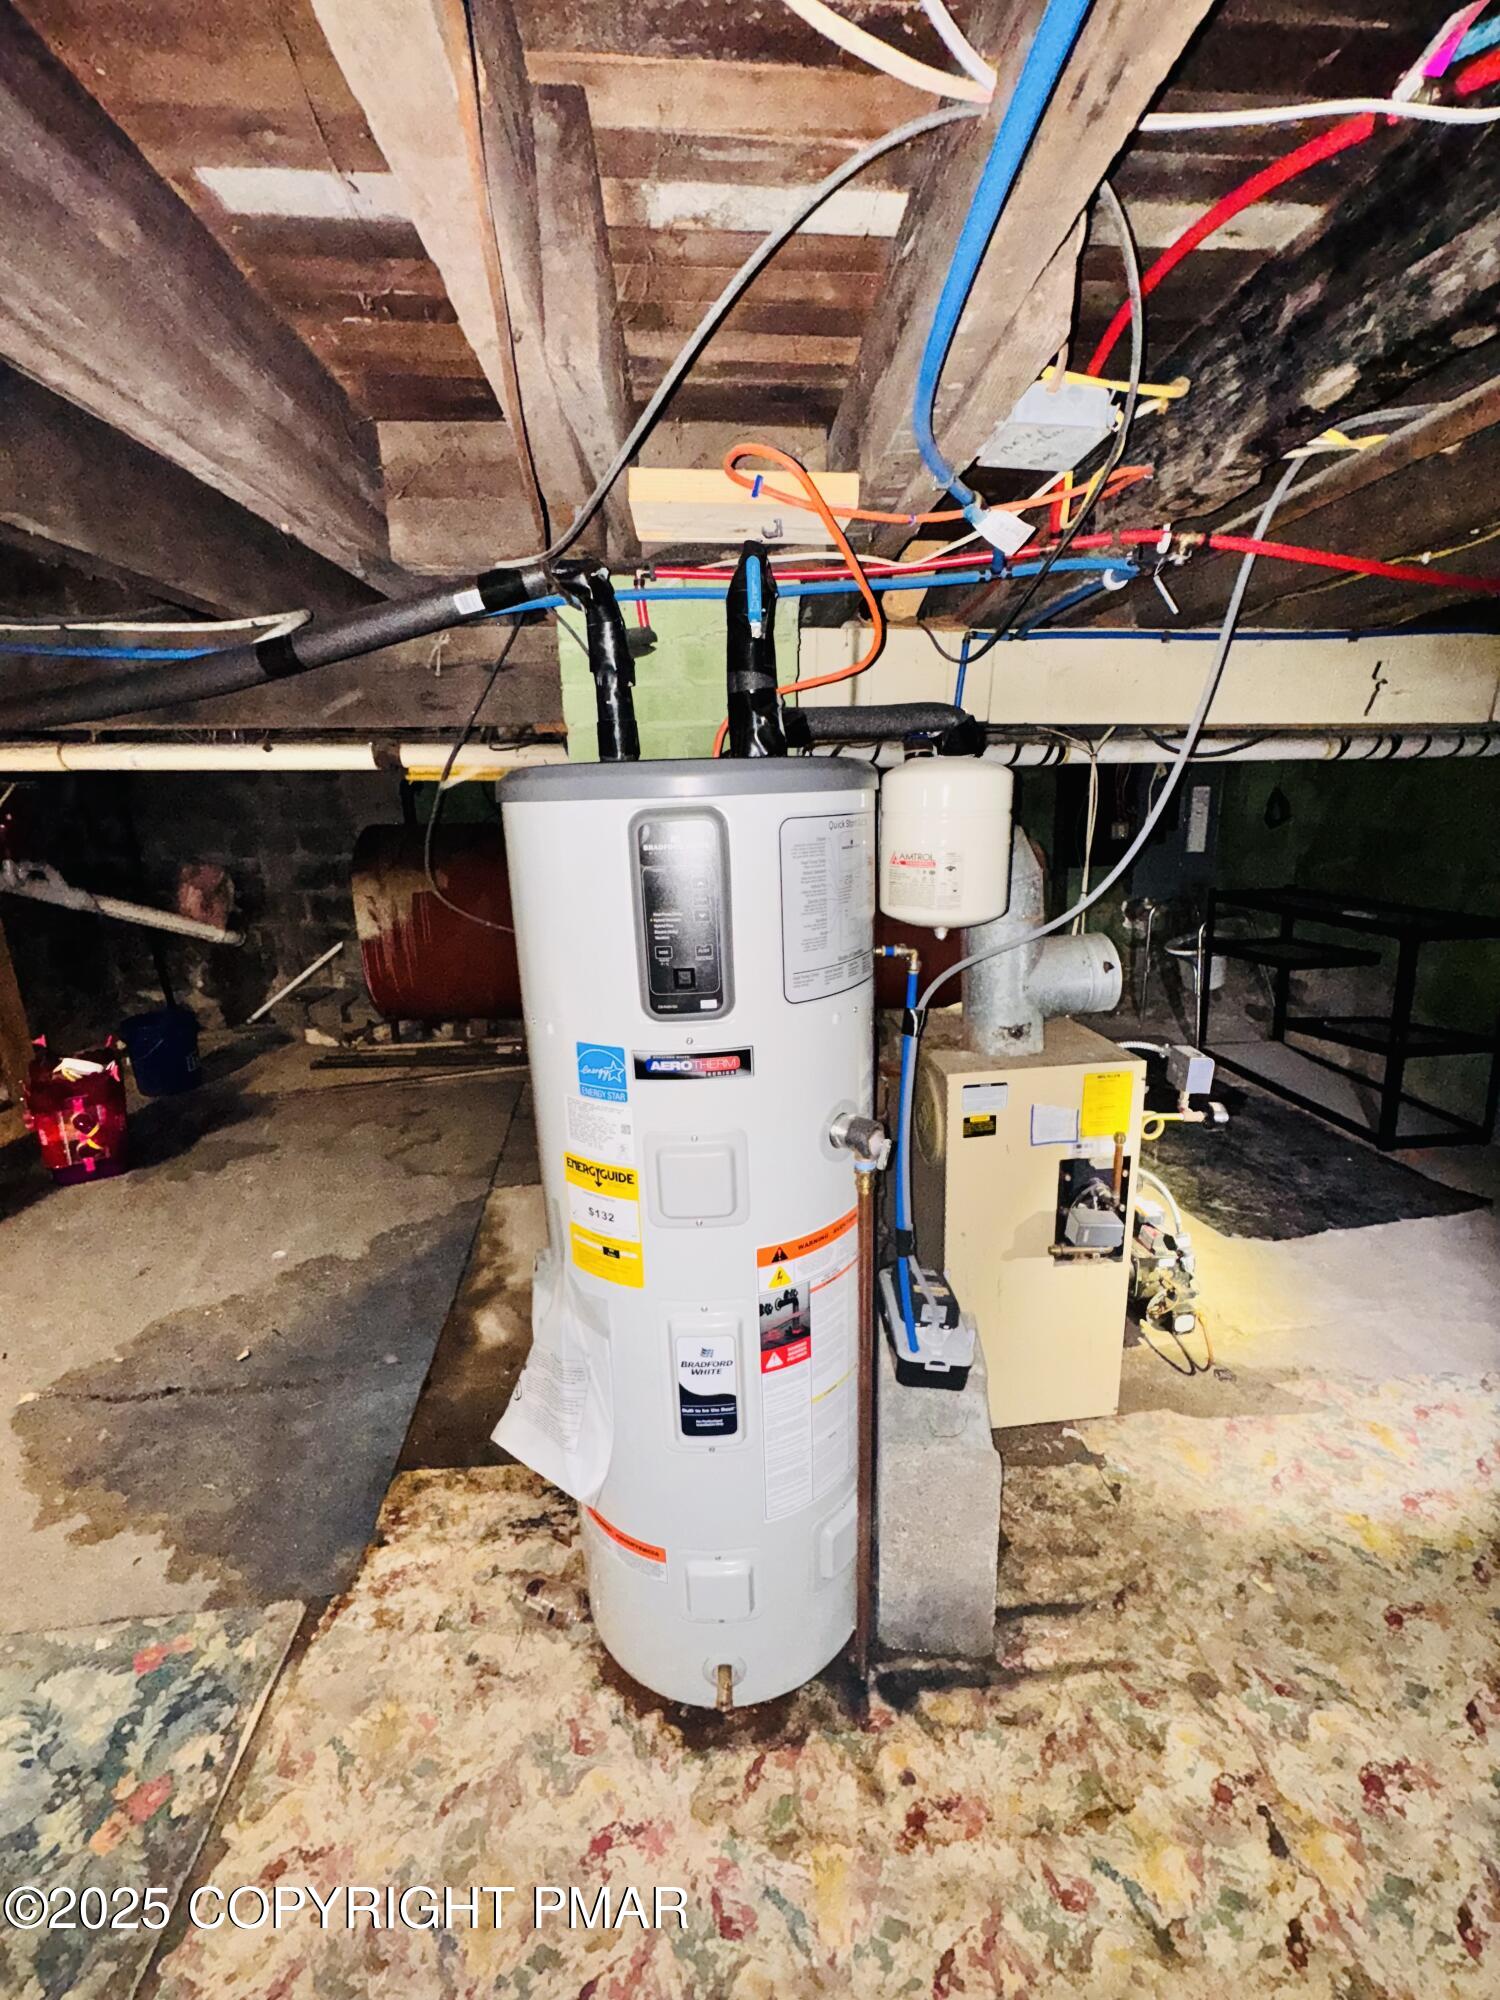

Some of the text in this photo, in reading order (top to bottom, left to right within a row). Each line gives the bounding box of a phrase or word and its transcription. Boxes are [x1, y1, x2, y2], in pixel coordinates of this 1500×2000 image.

[828, 819, 845, 831] Quick
[650, 1058, 737, 1072] AEROTHERM
[581, 1065, 610, 1081] energy
[581, 1086, 626, 1101] ENERGY STAR
[798, 1232, 829, 1250] WARNING
[680, 1359, 734, 1368] BRADFORD
[691, 1368, 722, 1376] WHITE
